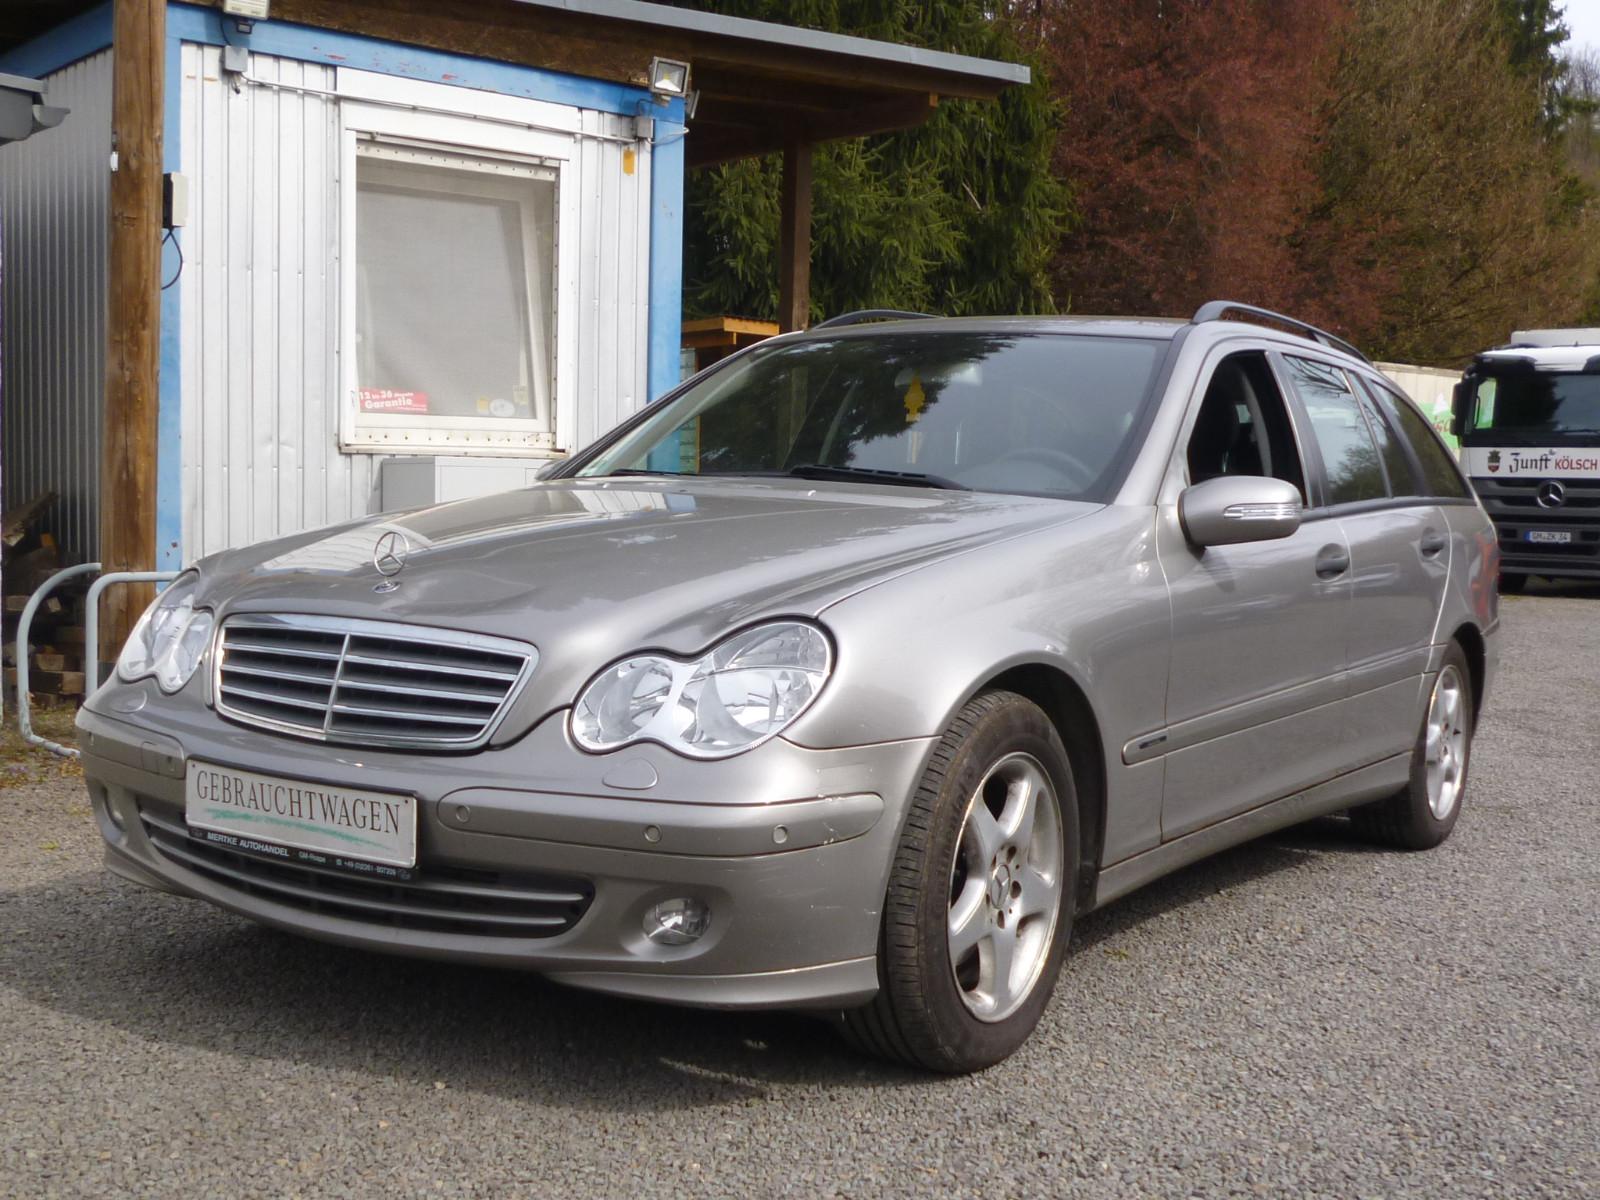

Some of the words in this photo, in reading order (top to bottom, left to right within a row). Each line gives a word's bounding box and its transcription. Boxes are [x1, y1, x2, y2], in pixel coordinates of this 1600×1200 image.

[364, 396, 413, 409] Garantie
[1554, 456, 1598, 470] KÖLSCH
[197, 770, 400, 835] GEBRAUCHTWAGEN
[207, 832, 238, 846] MERTKE
[239, 839, 289, 857] AUTOHANDEL
